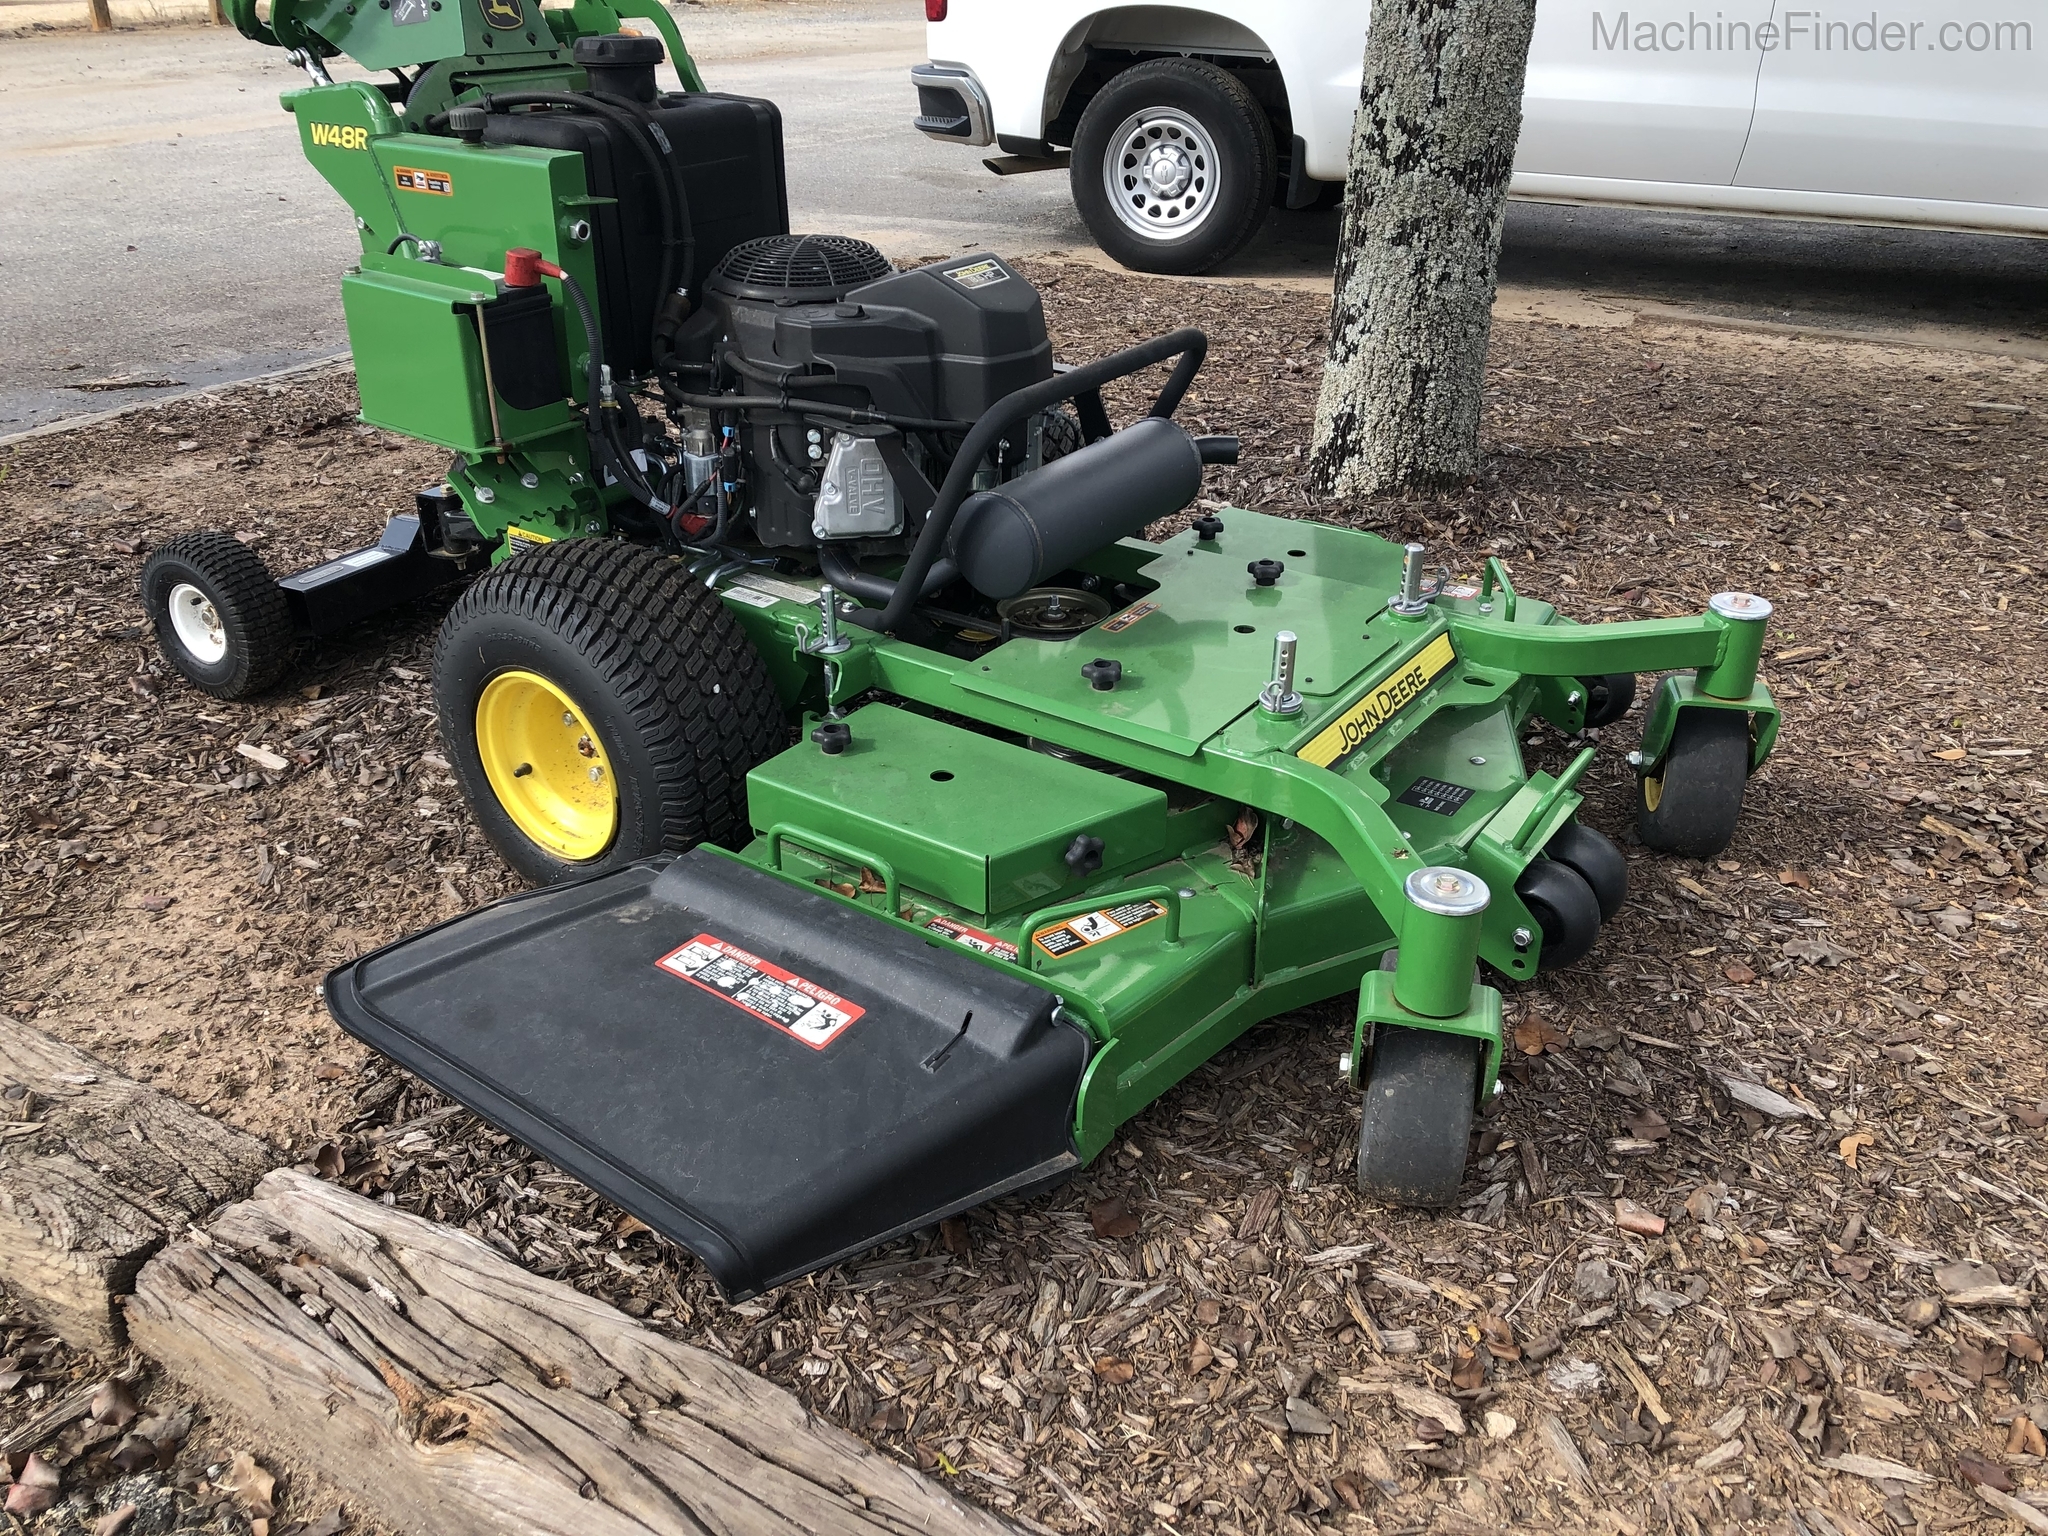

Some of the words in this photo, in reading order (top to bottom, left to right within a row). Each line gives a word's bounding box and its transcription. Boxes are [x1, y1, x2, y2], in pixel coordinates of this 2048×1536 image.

[310, 122, 368, 151] W48R
[847, 468, 858, 513] V-VALVE
[861, 458, 885, 514] OHV
[1338, 703, 1382, 752] JOHN
[1375, 665, 1428, 717] DEERE
[941, 919, 968, 933] DANGER
[722, 945, 761, 966] DANGER
[799, 982, 841, 1005] PELIGRO
